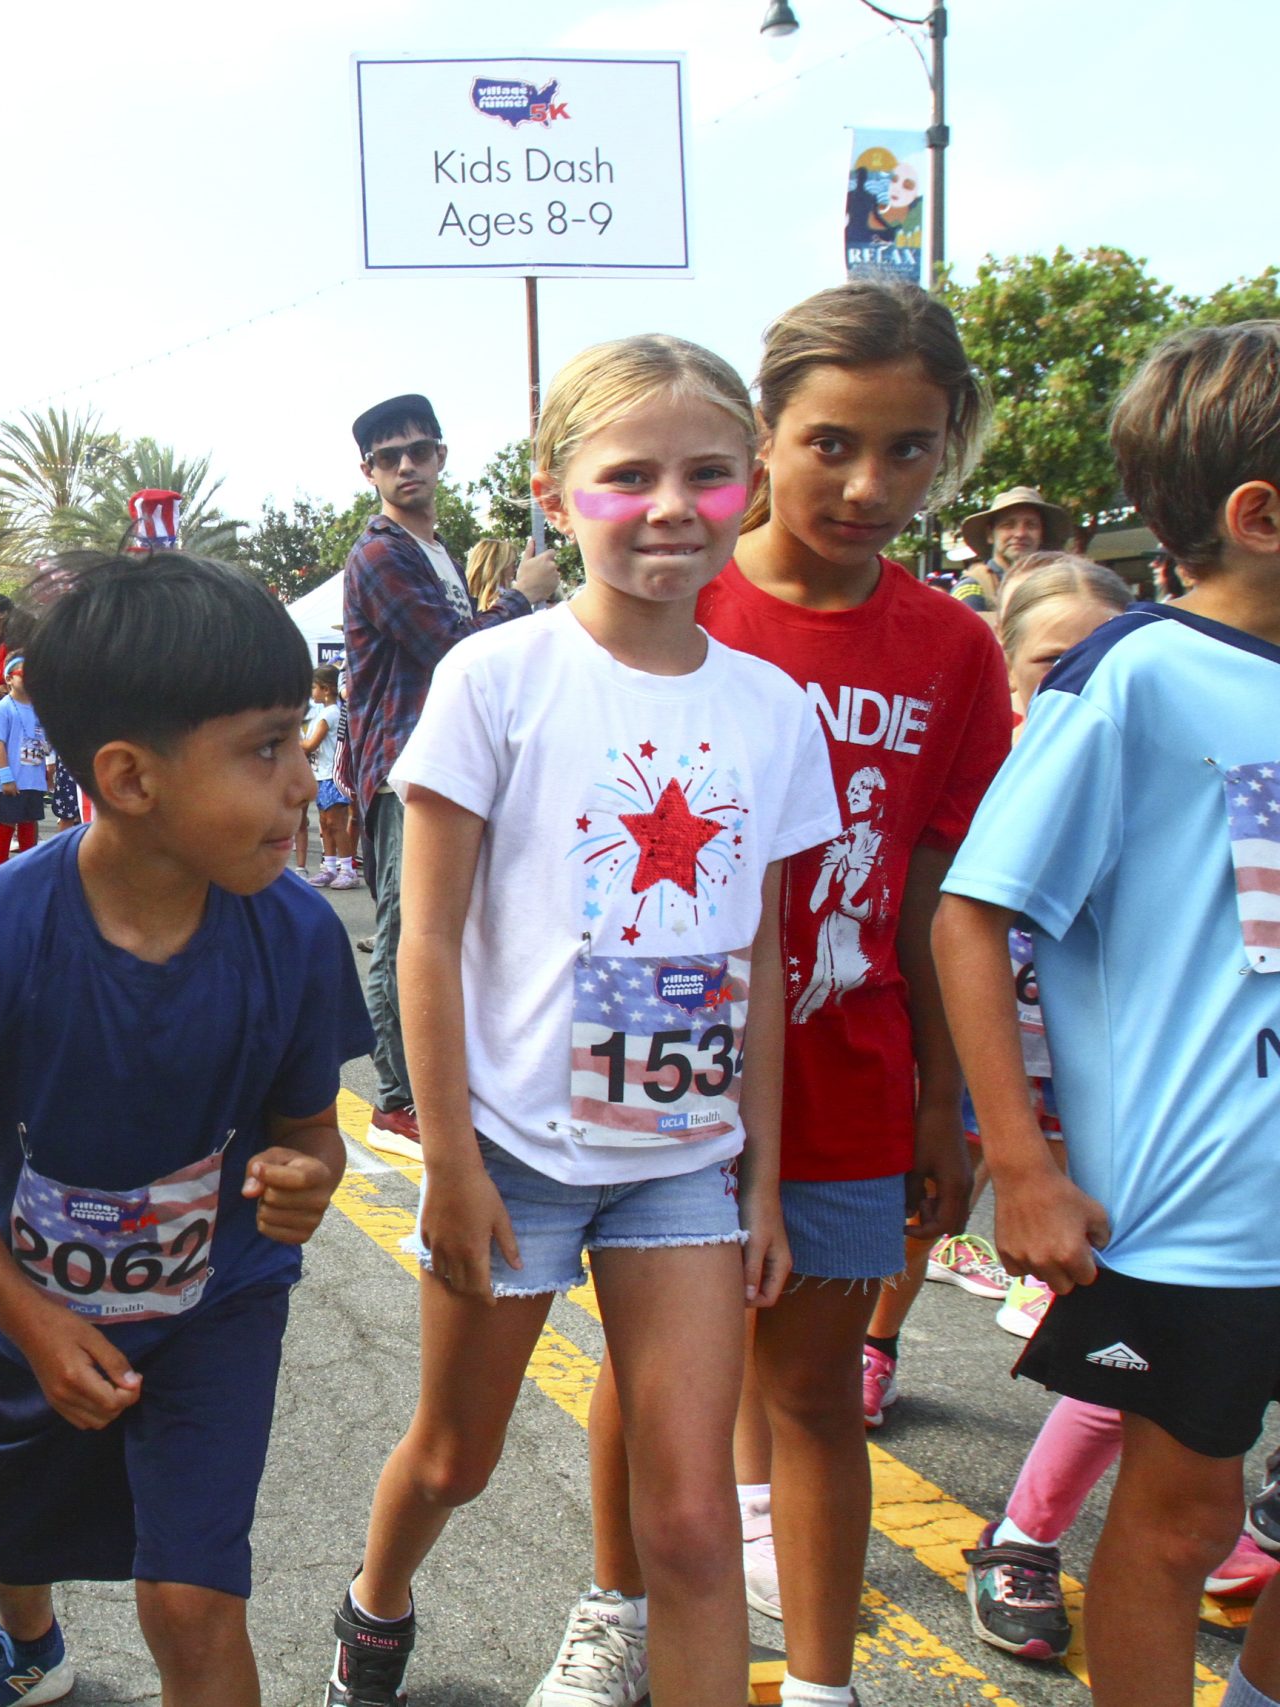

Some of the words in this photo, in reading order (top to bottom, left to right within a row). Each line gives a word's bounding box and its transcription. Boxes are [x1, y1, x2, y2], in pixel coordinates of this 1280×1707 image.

[478, 85, 528, 97] village
[478, 97, 529, 108] runner
[530, 102, 571, 122] 5K
[434, 146, 512, 183] Kids
[525, 147, 614, 183] Dash
[437, 202, 534, 246] Ages
[547, 200, 613, 235] 8-9
[848, 246, 917, 265] RELAX
[806, 681, 933, 755] NDIE
[662, 974, 704, 984] village
[662, 986, 704, 997] runner
[704, 984, 735, 1008] 5K
[661, 1117, 685, 1128] UCLA
[690, 1110, 721, 1126] Health
[71, 1202, 120, 1212] village
[70, 1211, 120, 1222] runner
[15, 1216, 209, 1295] 2062
[69, 1304, 97, 1314] UCLA
[105, 1303, 144, 1315] Health
